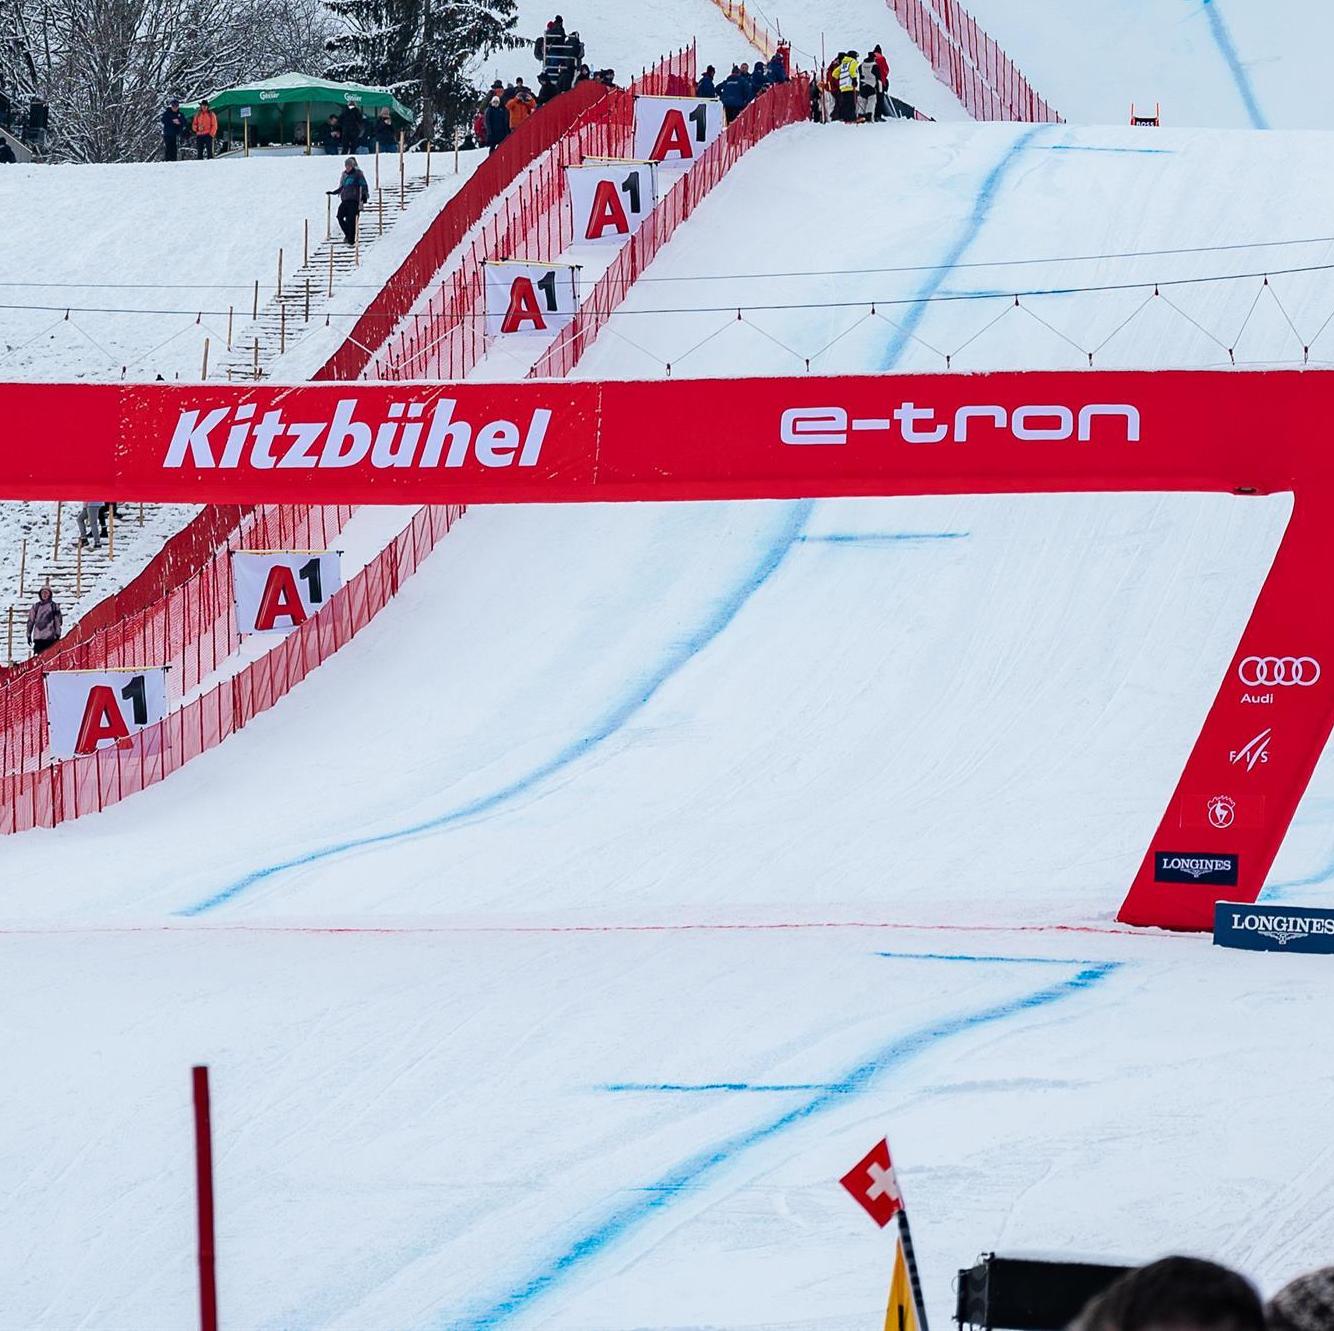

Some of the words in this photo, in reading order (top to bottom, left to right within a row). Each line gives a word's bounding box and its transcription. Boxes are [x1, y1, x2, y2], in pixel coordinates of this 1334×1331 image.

[648, 103, 707, 161] A1
[585, 171, 641, 239] A1
[500, 270, 558, 333] A1
[162, 398, 552, 469] Kitzbühel
[780, 401, 1140, 445] e-tron
[254, 557, 322, 631] A1
[74, 675, 148, 755] A1
[1240, 693, 1274, 704] Audi
[1162, 857, 1231, 871] LONGINES
